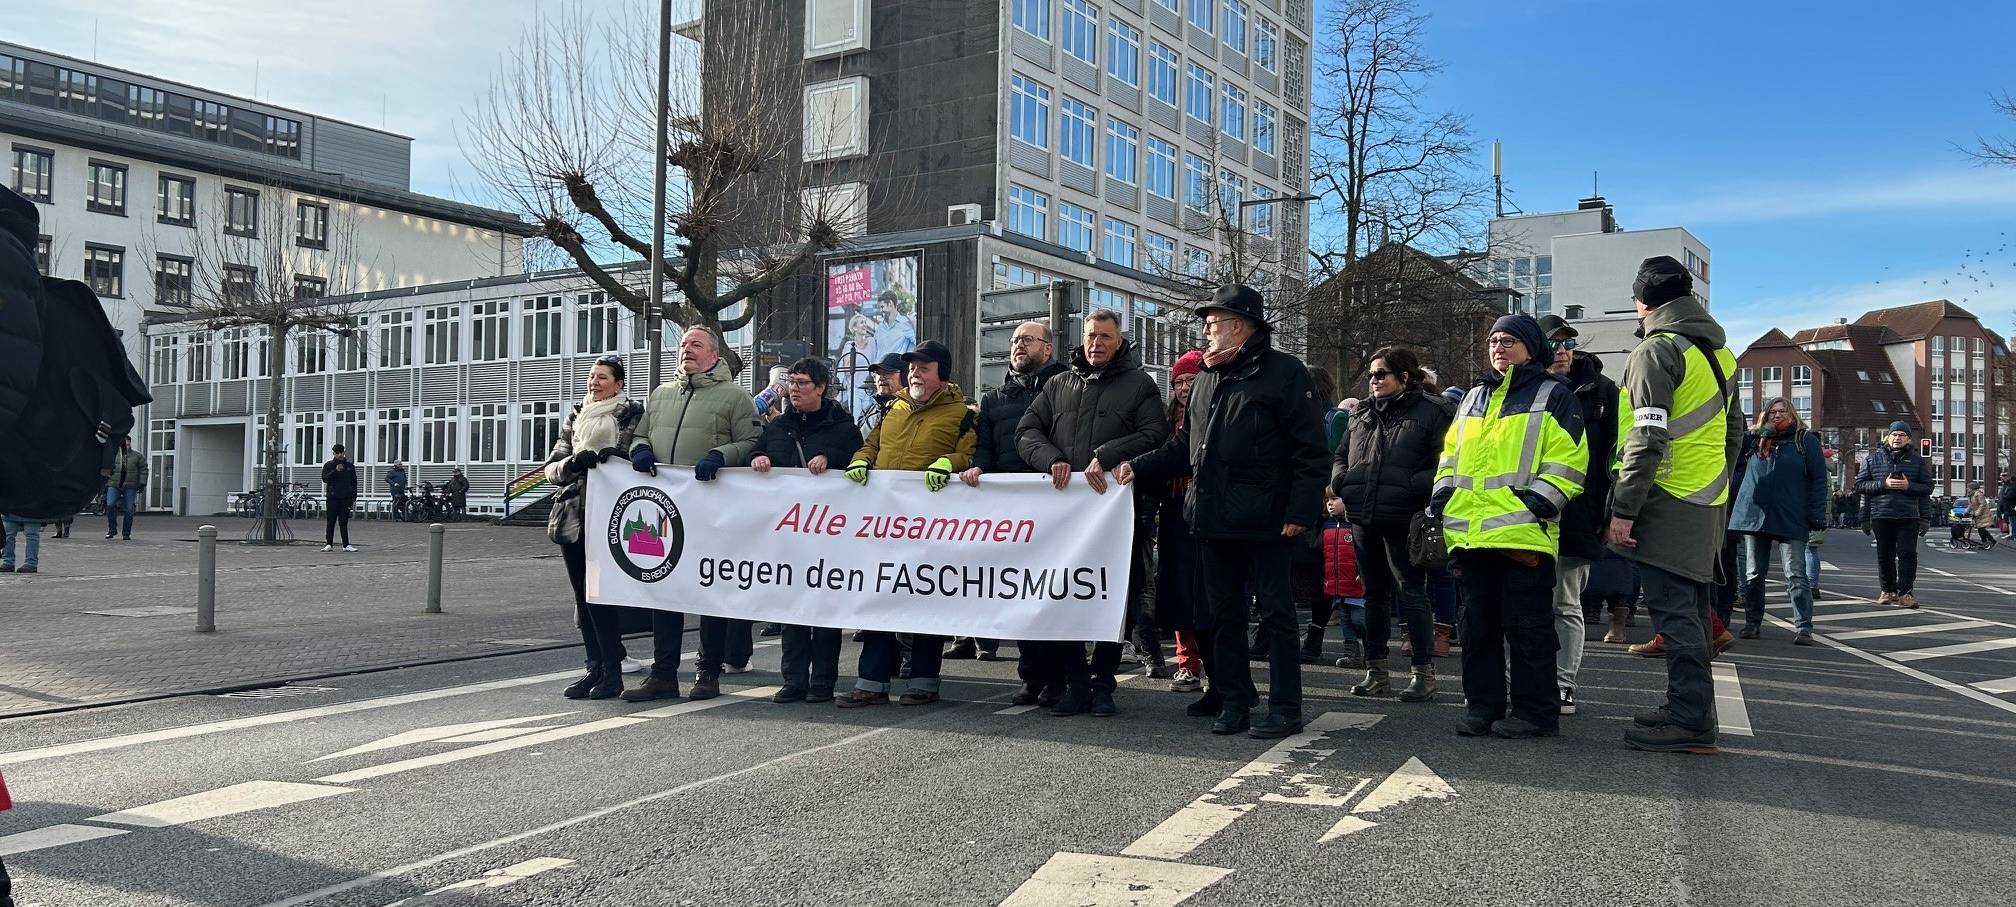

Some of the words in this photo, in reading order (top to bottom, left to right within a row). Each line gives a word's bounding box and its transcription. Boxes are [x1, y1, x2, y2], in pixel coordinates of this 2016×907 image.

[609, 505, 623, 544] BÜNDNIS
[619, 489, 678, 519] RECKLINGHAUSEN
[775, 502, 847, 536] Alle
[855, 515, 1035, 543] zusammen
[641, 572, 651, 580] ES
[651, 560, 673, 580] REICHT
[699, 556, 793, 591] gegen
[806, 558, 864, 592] den
[875, 562, 1108, 601] FASCHISMUS!
